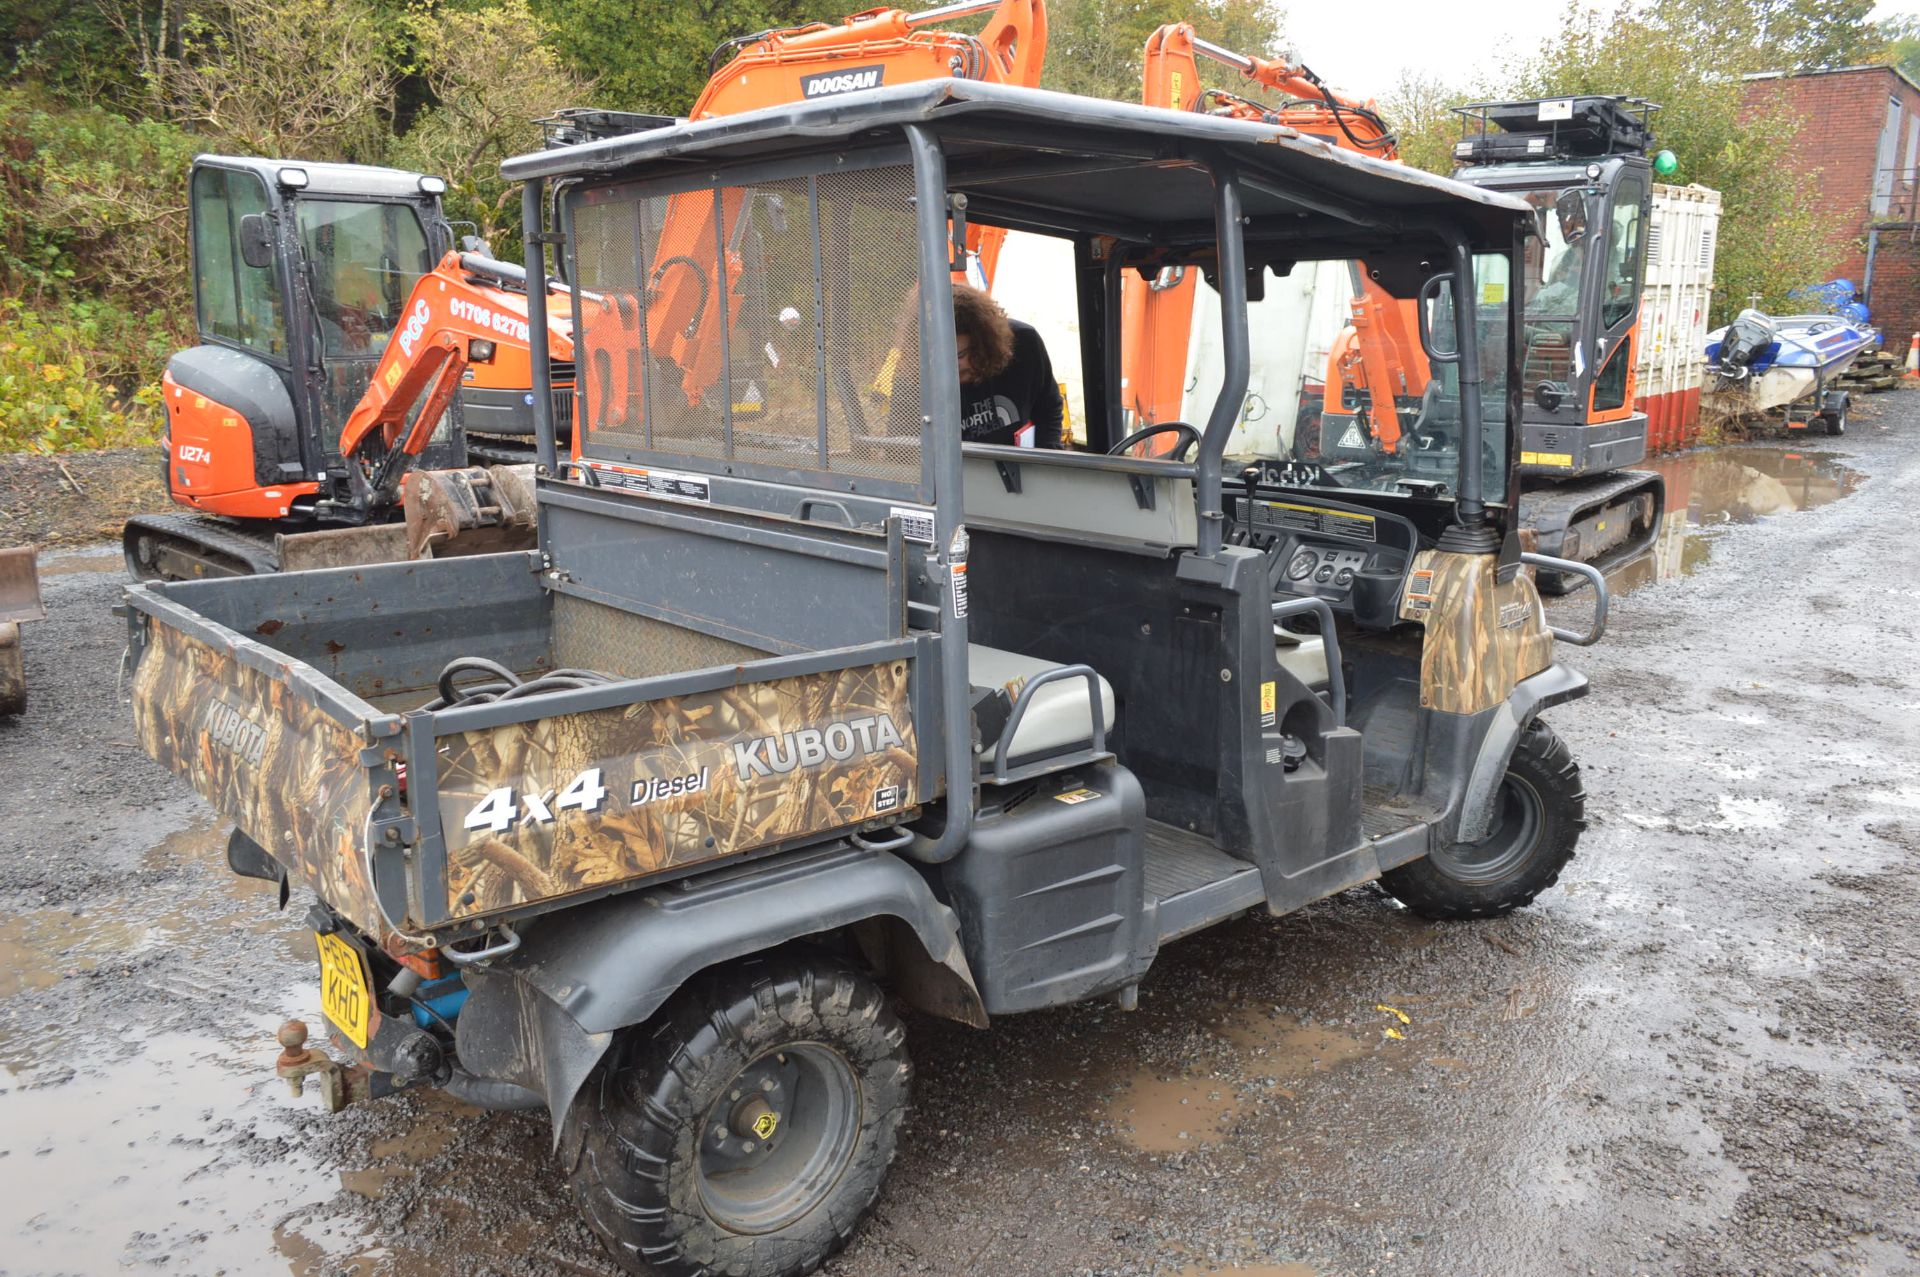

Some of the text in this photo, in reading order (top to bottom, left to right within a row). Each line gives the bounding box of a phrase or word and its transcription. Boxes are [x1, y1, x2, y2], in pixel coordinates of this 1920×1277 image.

[807, 71, 878, 96] DOOSAN
[450, 298, 491, 328] 01706
[399, 299, 430, 358] PGC
[971, 398, 992, 413] THE
[180, 445, 211, 464] U27-4
[202, 697, 268, 769] KUBOTA
[464, 713, 904, 834] 4x4 Diesel KUBOTA
[877, 798, 895, 807] STEP
[328, 968, 359, 1028] KHO
